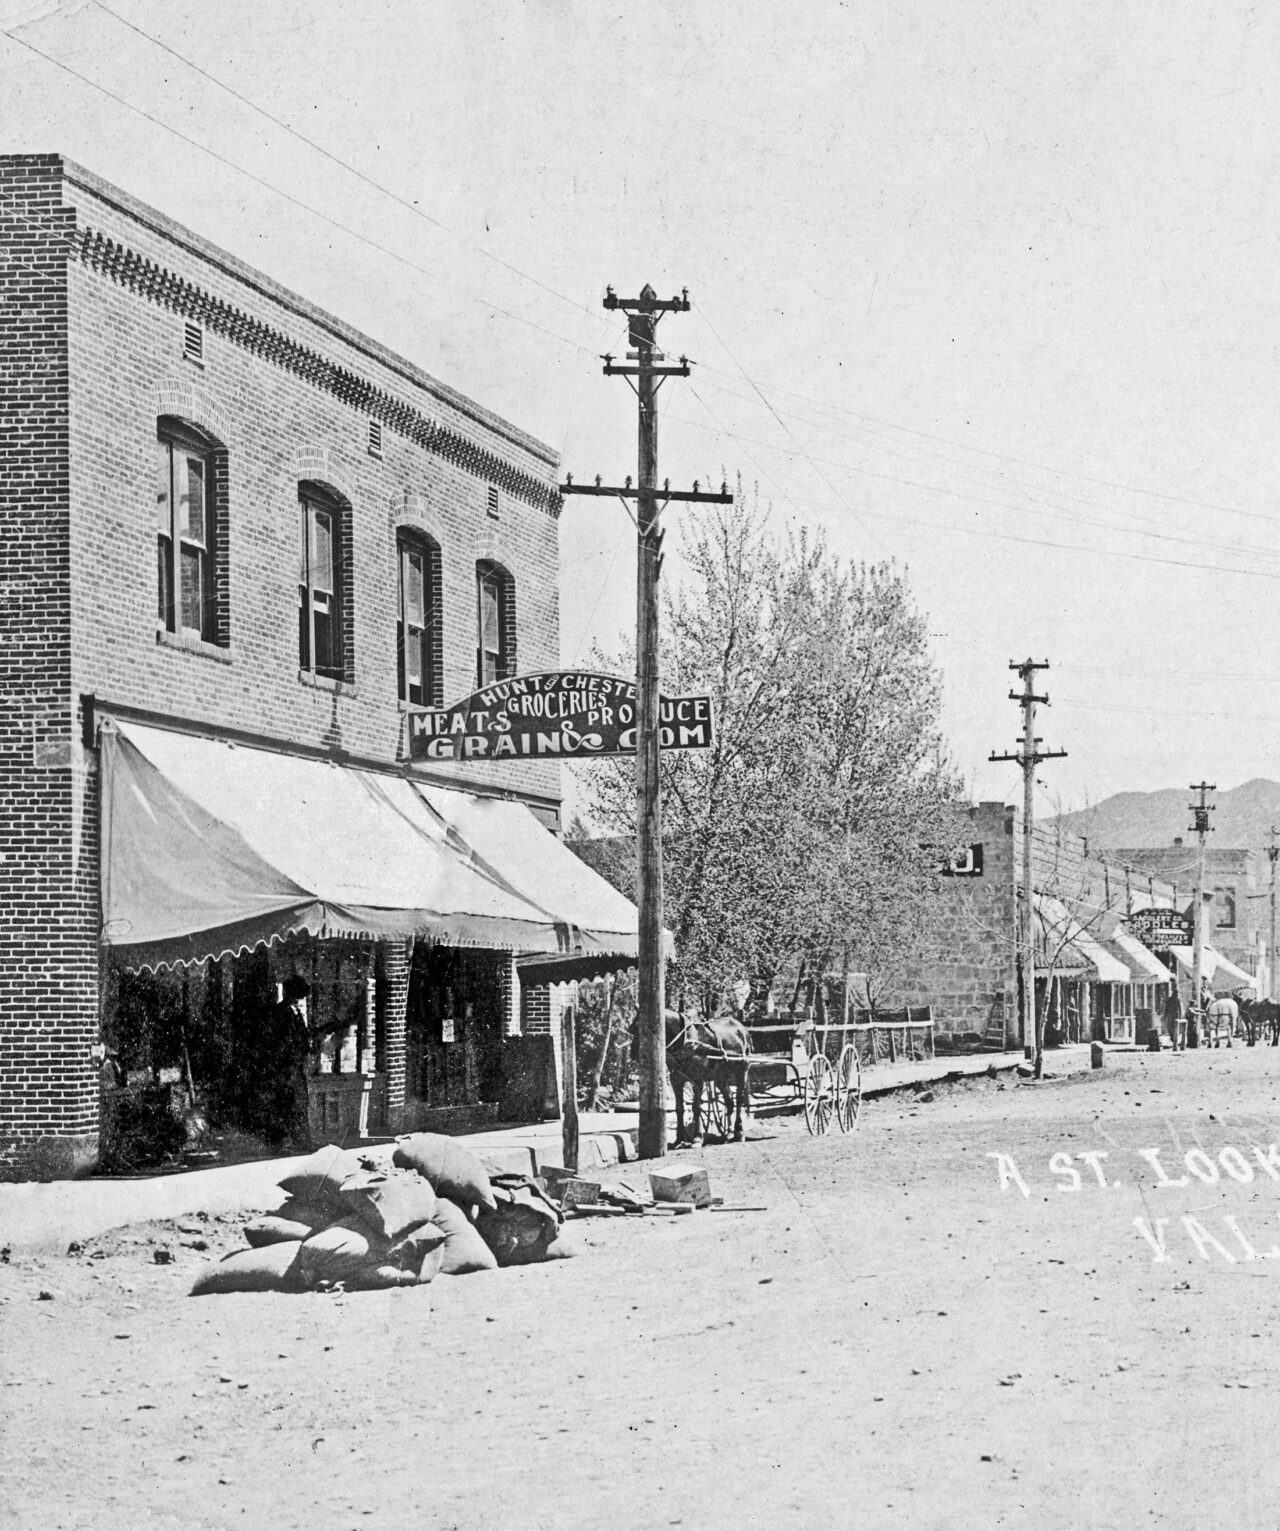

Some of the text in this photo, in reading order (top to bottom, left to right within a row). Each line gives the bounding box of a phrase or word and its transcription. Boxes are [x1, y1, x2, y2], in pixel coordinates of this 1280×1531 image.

[480, 676, 543, 707] HUNT
[561, 675, 637, 700] CHESTE
[507, 690, 607, 719] GROCERIES
[413, 700, 708, 736] MEATS PROUCE
[427, 731, 560, 758] GRAIN
[561, 720, 605, 752] &
